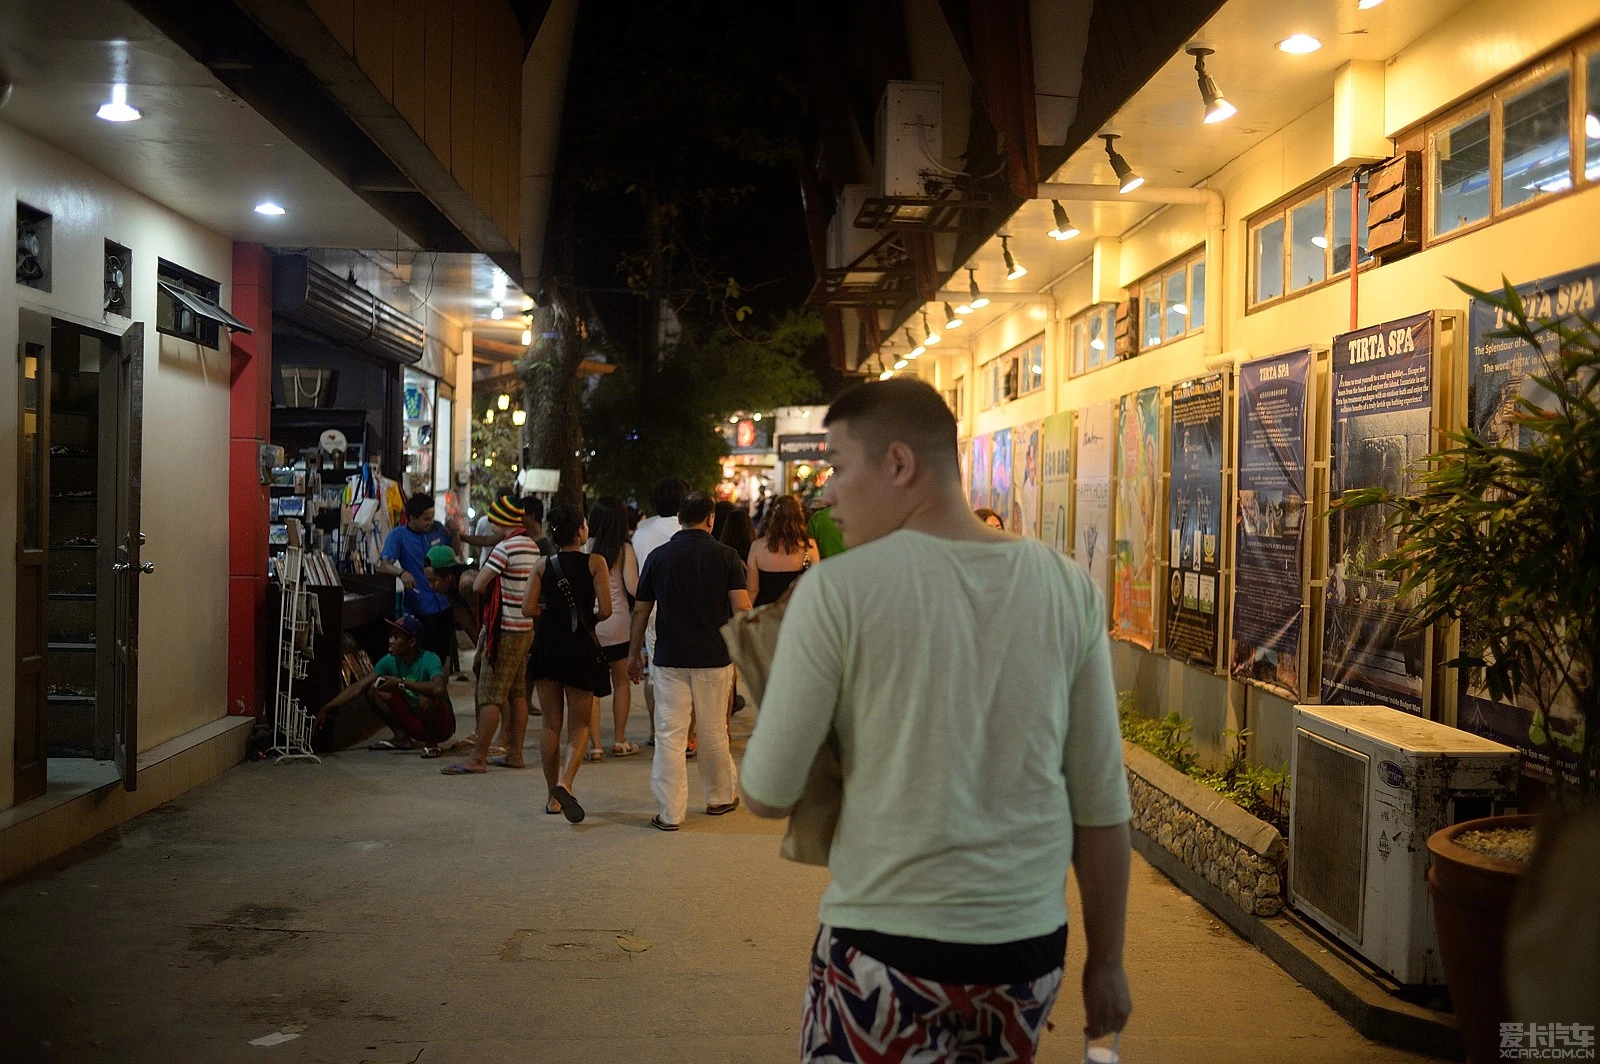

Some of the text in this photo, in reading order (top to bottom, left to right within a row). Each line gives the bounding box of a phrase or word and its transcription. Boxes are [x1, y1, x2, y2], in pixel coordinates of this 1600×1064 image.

[1556, 277, 1594, 316] SPA
[1348, 326, 1414, 364] TIRTA SPA
[1474, 346, 1484, 356] The
[1485, 342, 1513, 356] Splendour
[1514, 336, 1521, 348] of
[1260, 363, 1290, 382] TIRTA SPA
[1484, 364, 1494, 374] The
[1494, 362, 1508, 372] word
[1532, 355, 1538, 364] in
[1351, 685, 1365, 696] available
[1400, 699, 1412, 710] Budget
[1529, 749, 1537, 759] Spa
[1538, 753, 1550, 762] men
[1525, 761, 1544, 772] counter
